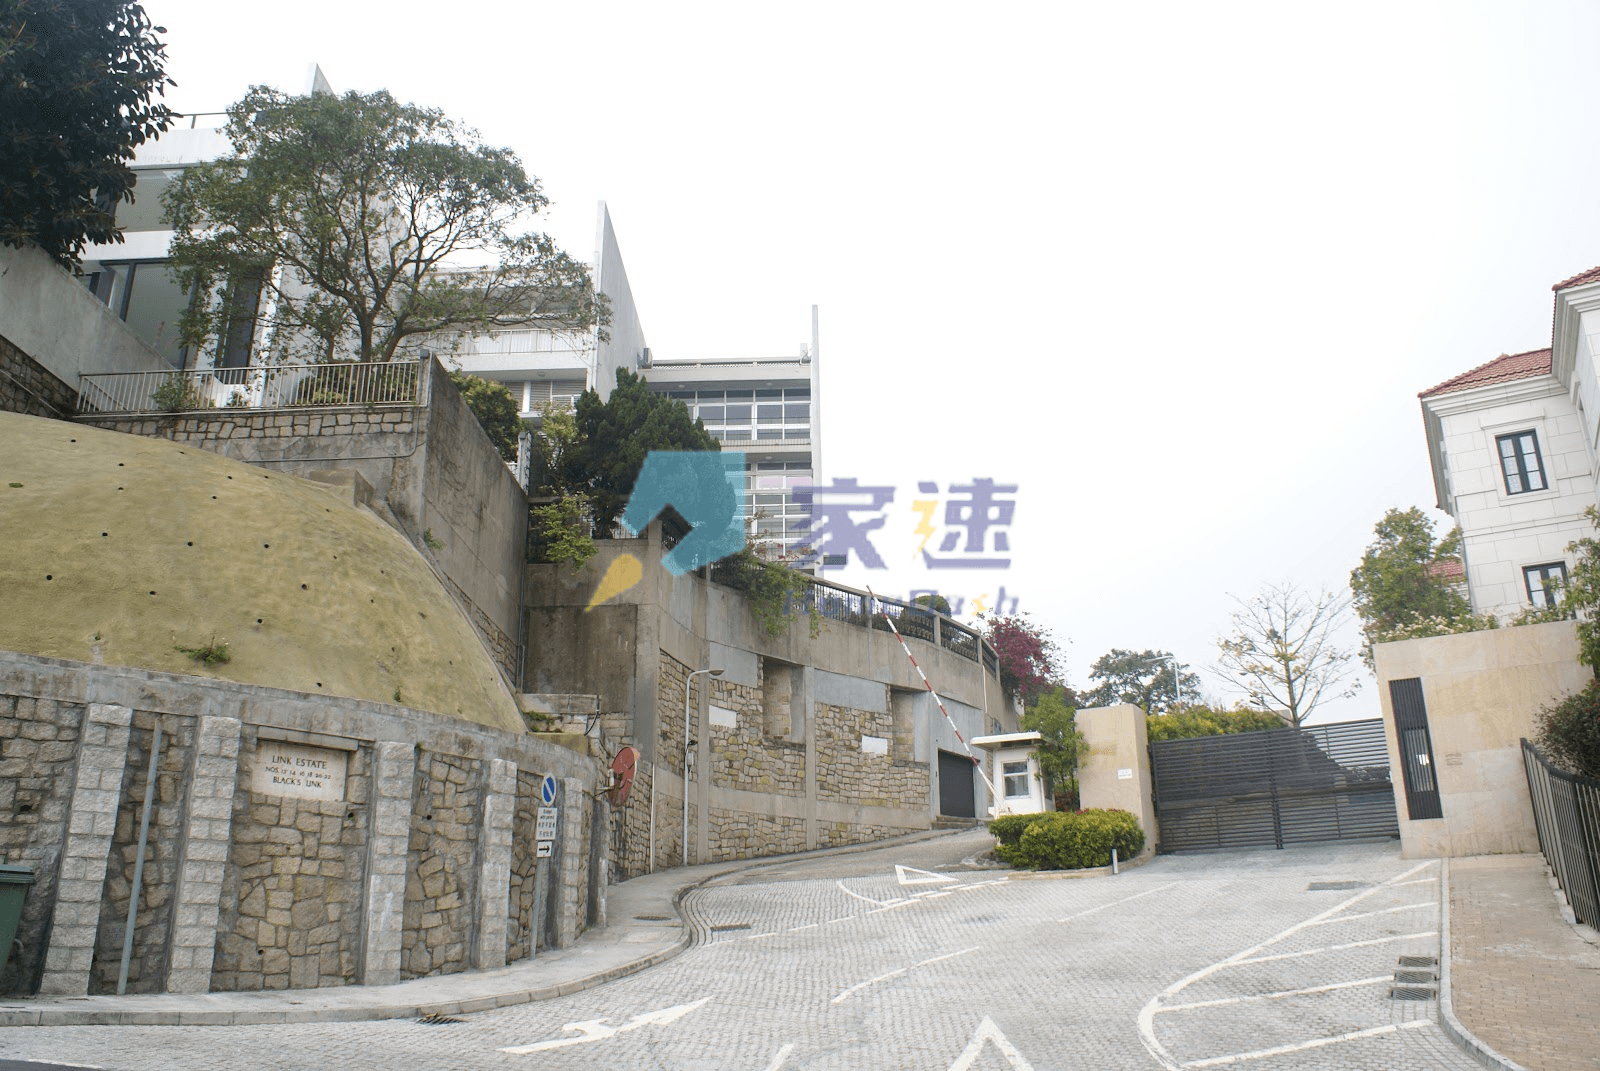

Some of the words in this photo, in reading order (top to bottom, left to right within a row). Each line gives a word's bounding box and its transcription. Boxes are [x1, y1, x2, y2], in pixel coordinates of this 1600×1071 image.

[272, 755, 292, 765] LINK
[295, 757, 328, 769] ESTATE
[305, 779, 322, 788] LINK
